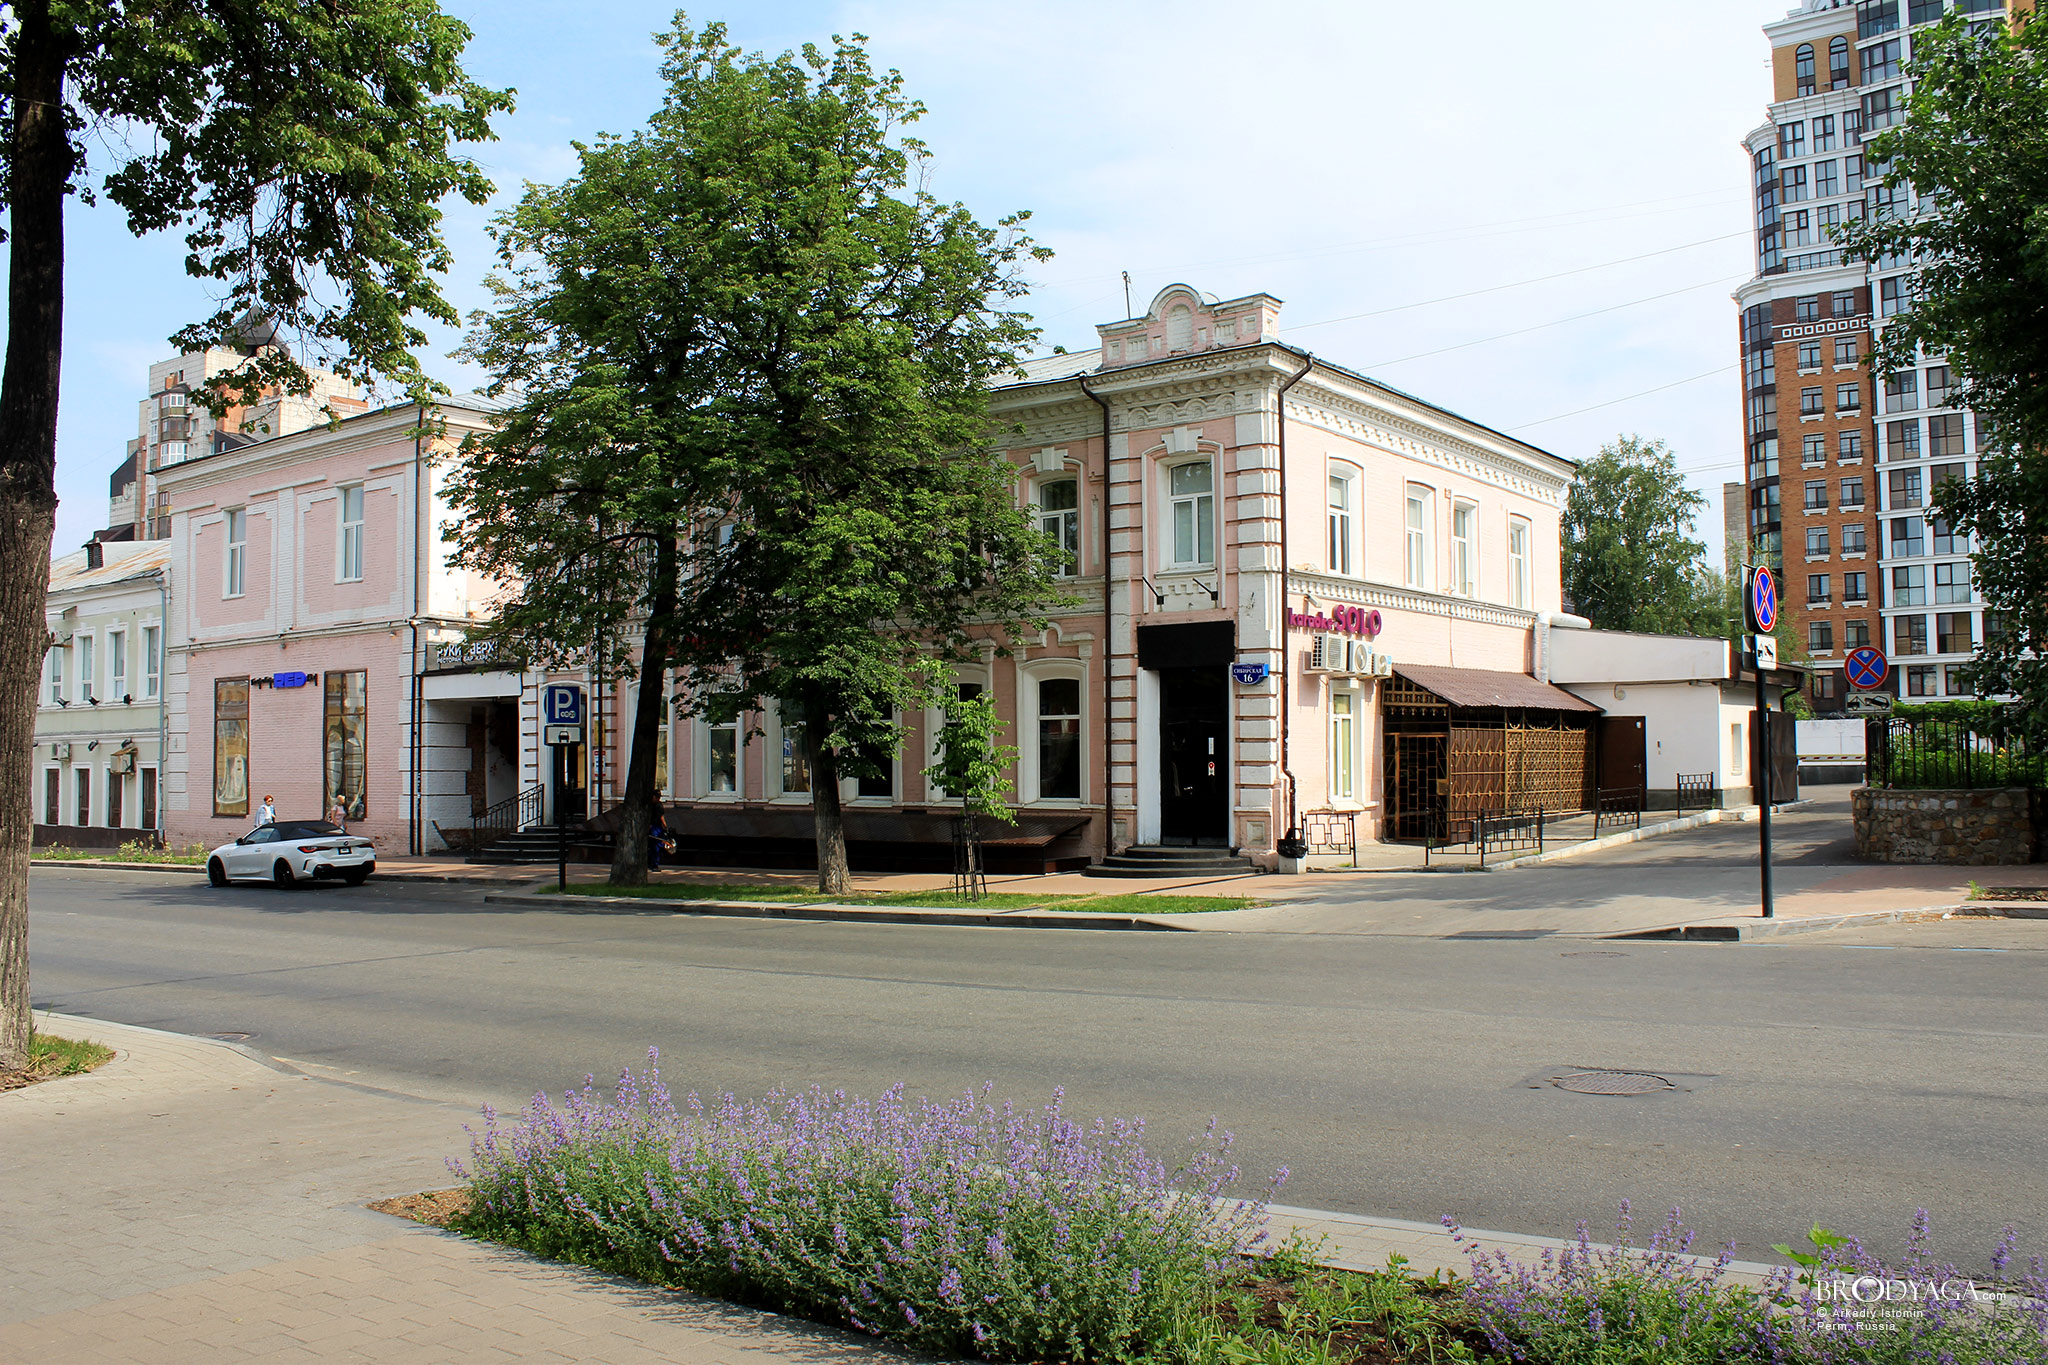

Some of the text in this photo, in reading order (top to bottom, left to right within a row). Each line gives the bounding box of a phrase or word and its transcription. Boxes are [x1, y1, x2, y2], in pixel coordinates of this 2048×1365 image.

[1287, 604, 1382, 635] karaoke SOLO
[1243, 674, 1253, 682] 16
[554, 689, 573, 719] P
